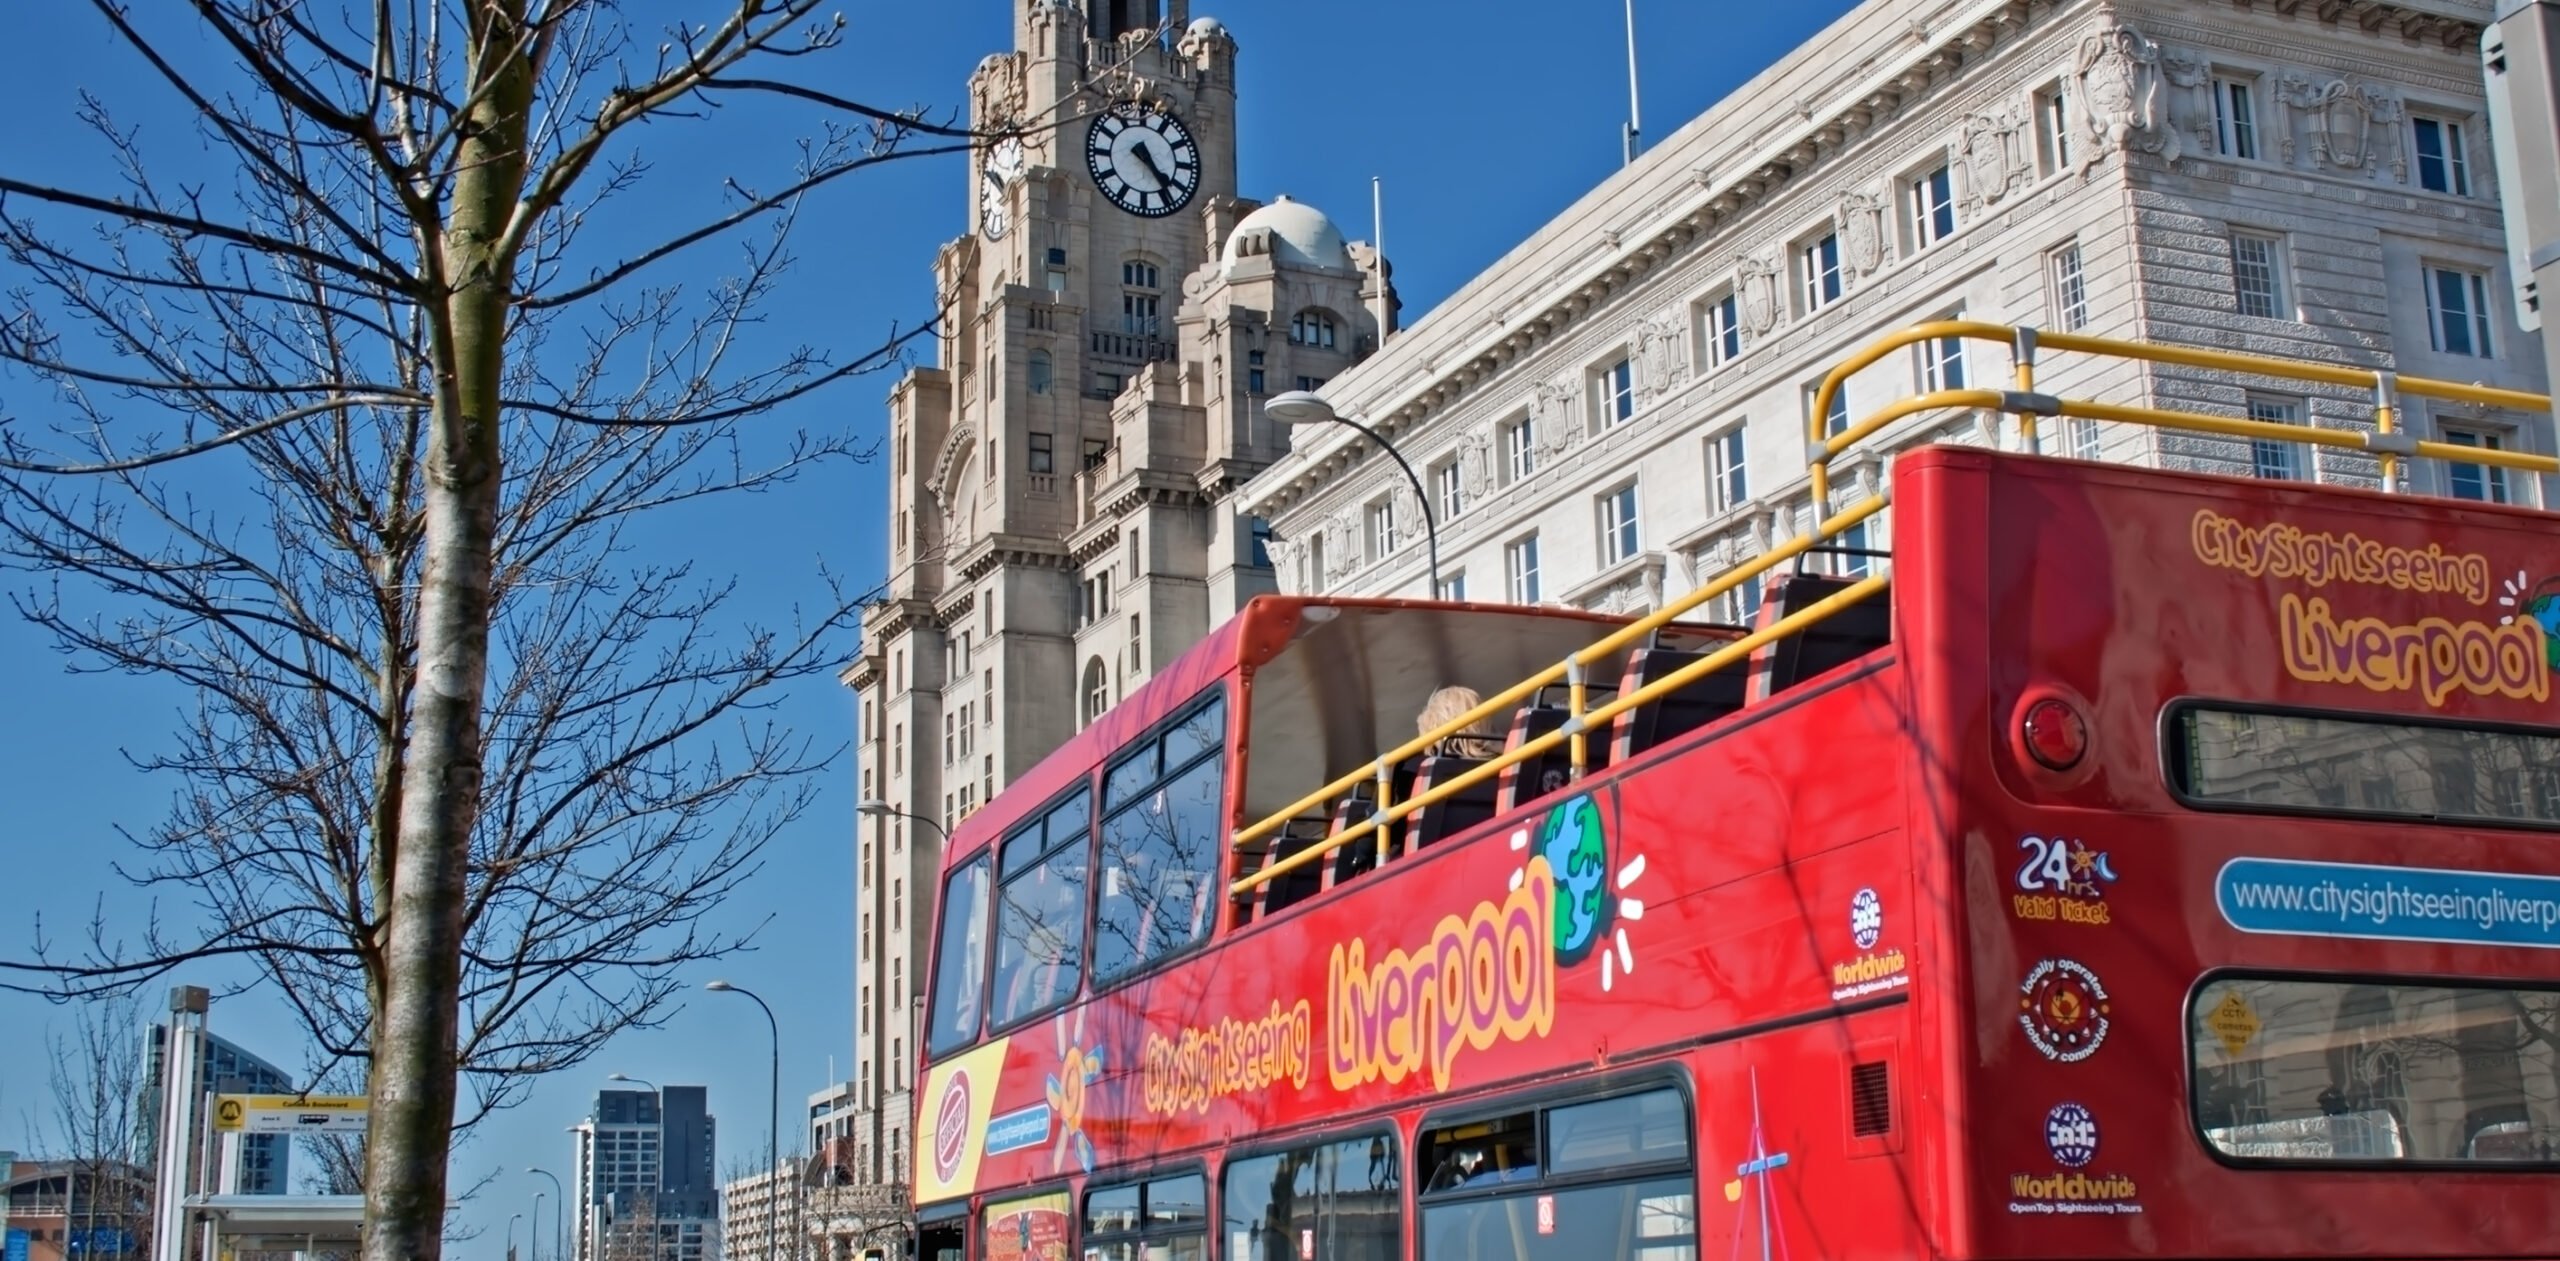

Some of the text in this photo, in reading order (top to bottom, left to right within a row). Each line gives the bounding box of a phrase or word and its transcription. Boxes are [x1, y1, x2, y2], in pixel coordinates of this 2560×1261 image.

[2280, 593, 2549, 707] Liverpool
[2019, 836, 2071, 891] 24
[2014, 895, 2110, 924] Valid Ticket
[2232, 880, 2560, 933] www.citysightseeingliverp
[1328, 855, 1555, 1092] Liverpool
[1833, 949, 1905, 985] Worldwide
[2022, 959, 2108, 1000] locally operated
[2222, 1008, 2247, 1018] CCTV
[2020, 1015, 2109, 1062] globally connected
[2012, 1172, 2136, 1200] Worldwide
[2009, 1203, 2143, 1214] OpenTop Sightseeing Tours
